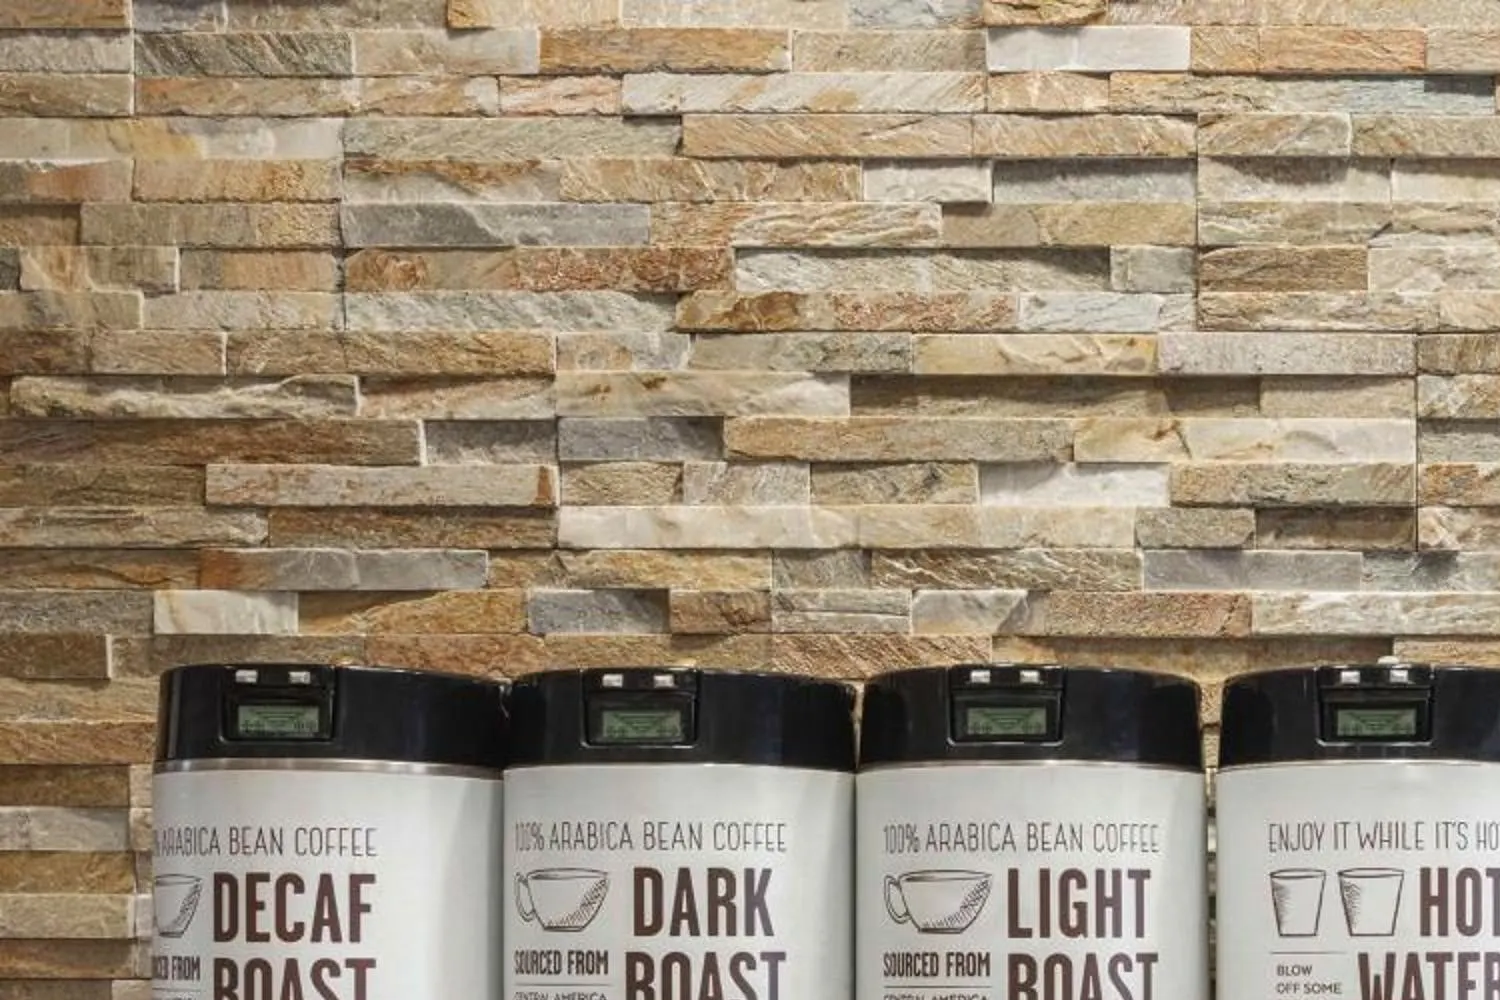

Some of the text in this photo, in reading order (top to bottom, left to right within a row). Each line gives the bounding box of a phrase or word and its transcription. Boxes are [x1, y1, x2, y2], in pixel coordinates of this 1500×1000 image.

[229, 827, 283, 855] BEAN
[295, 827, 378, 857] COFFEE
[550, 822, 633, 851] ARABICA
[643, 822, 703, 851] BEAN
[713, 823, 787, 852] COFFEE
[884, 822, 1159, 854] 100% ARABICA BEAN COFFEE
[1269, 822, 1325, 852] ENJOY
[1333, 822, 1350, 850] IT
[1358, 821, 1425, 850] WHILE
[1435, 821, 1468, 850] IT'S
[213, 872, 376, 943] DECAF
[633, 867, 775, 937] DARK
[1007, 868, 1152, 939] LIGHT
[514, 950, 609, 975] SOURCED FROM
[884, 952, 990, 977] SOURCED FROM
[1276, 965, 1312, 976] BLOW
[1276, 983, 1342, 995] OFF SOME
